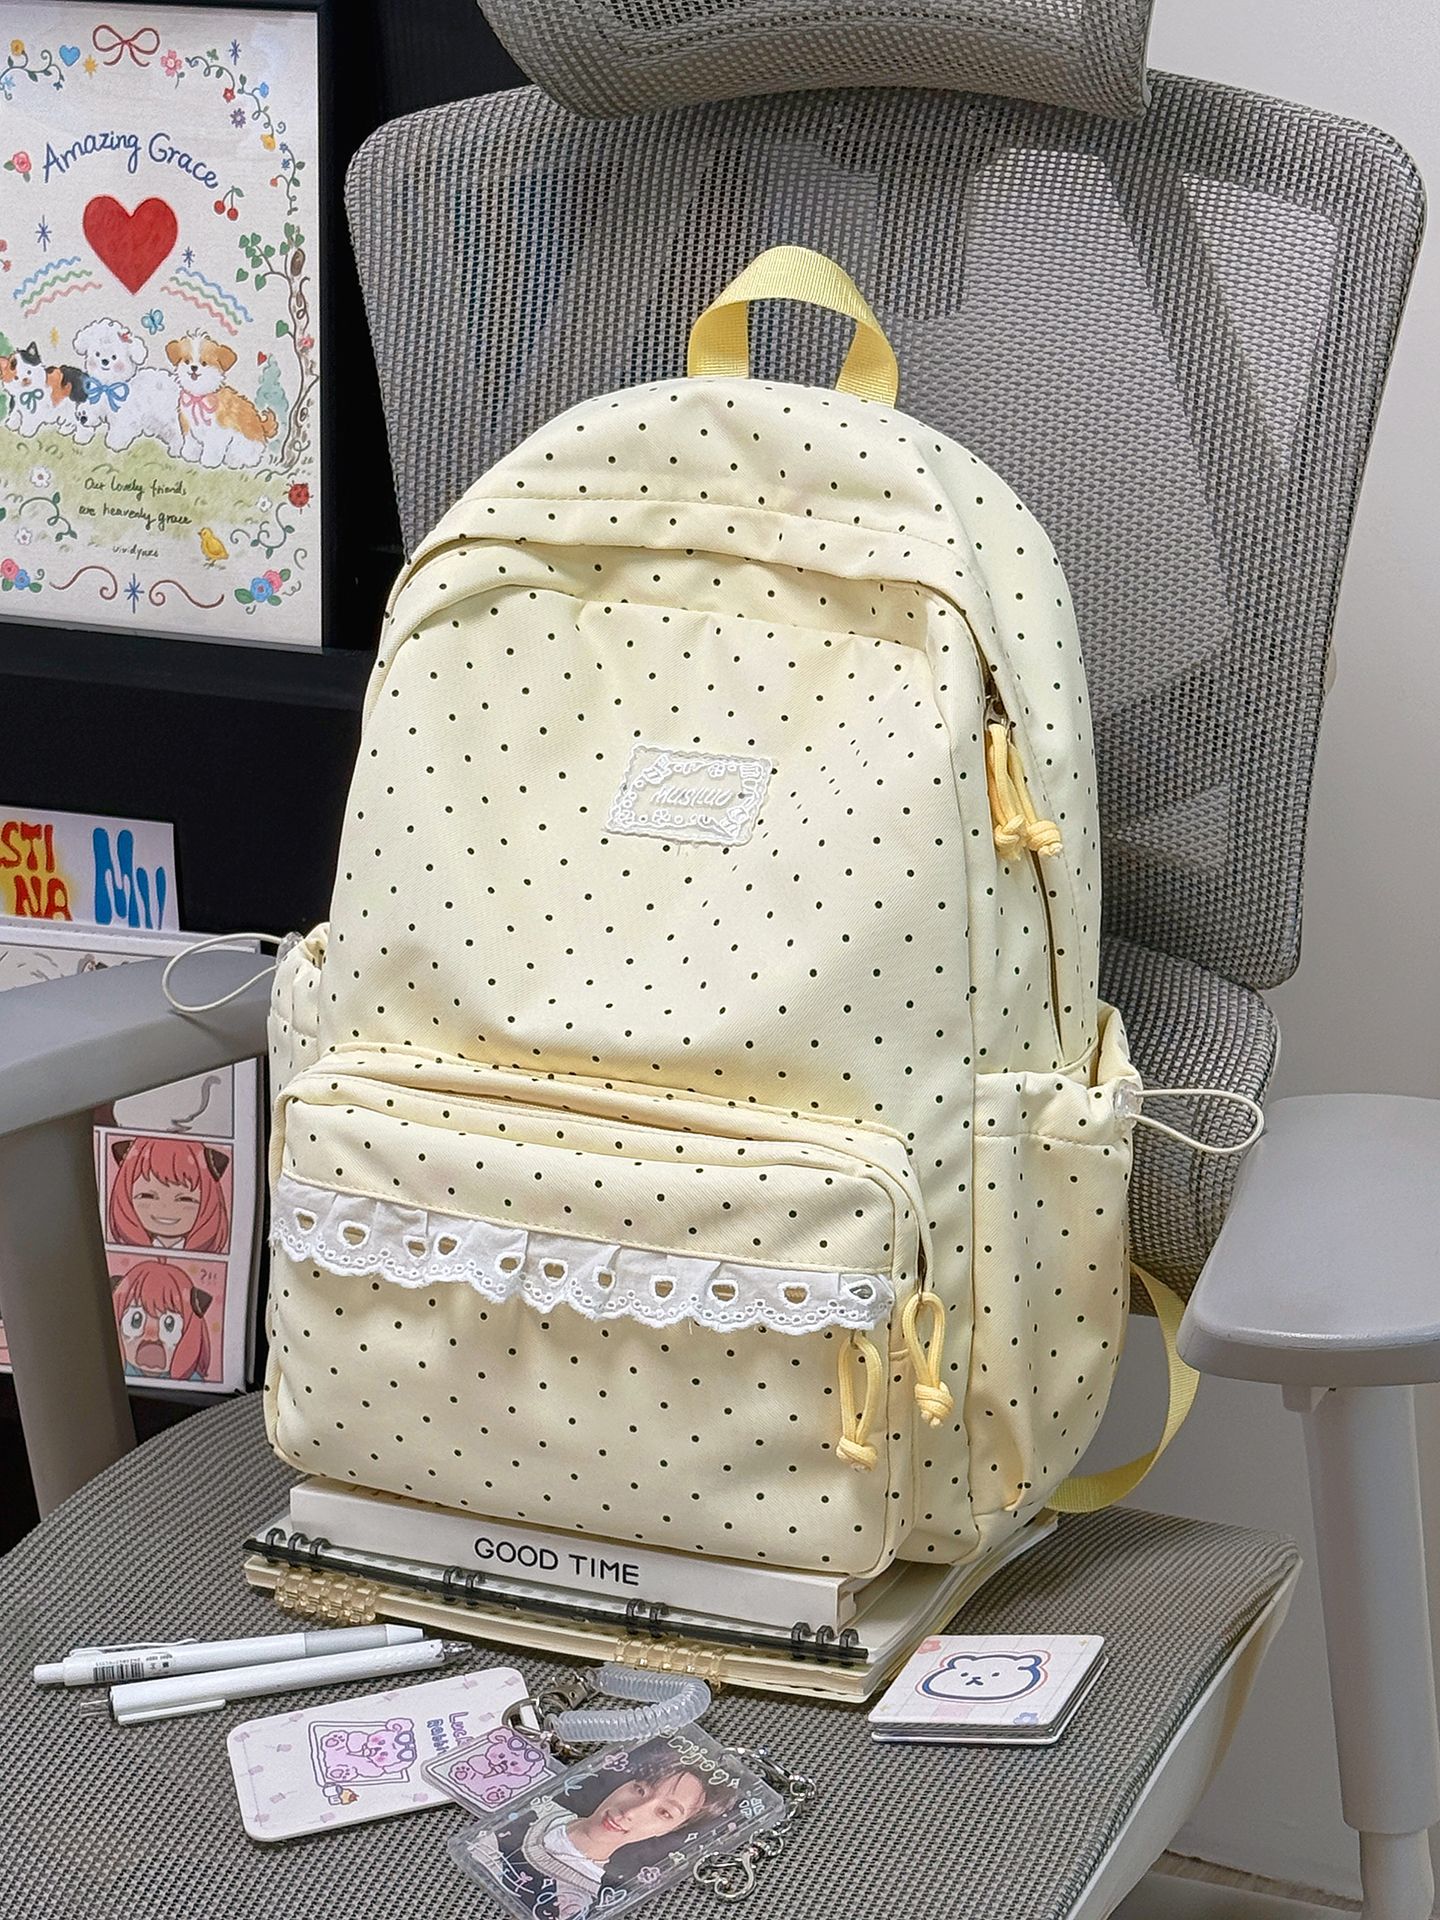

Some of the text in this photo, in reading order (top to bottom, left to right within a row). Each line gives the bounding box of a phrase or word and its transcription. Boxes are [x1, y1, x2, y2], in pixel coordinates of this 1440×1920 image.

[42, 130, 219, 189] Amazing Grace
[84, 476, 187, 501] Our lovely friends
[79, 503, 192, 531] are heavenly grace
[474, 1537, 639, 1586] GOOD TIME
